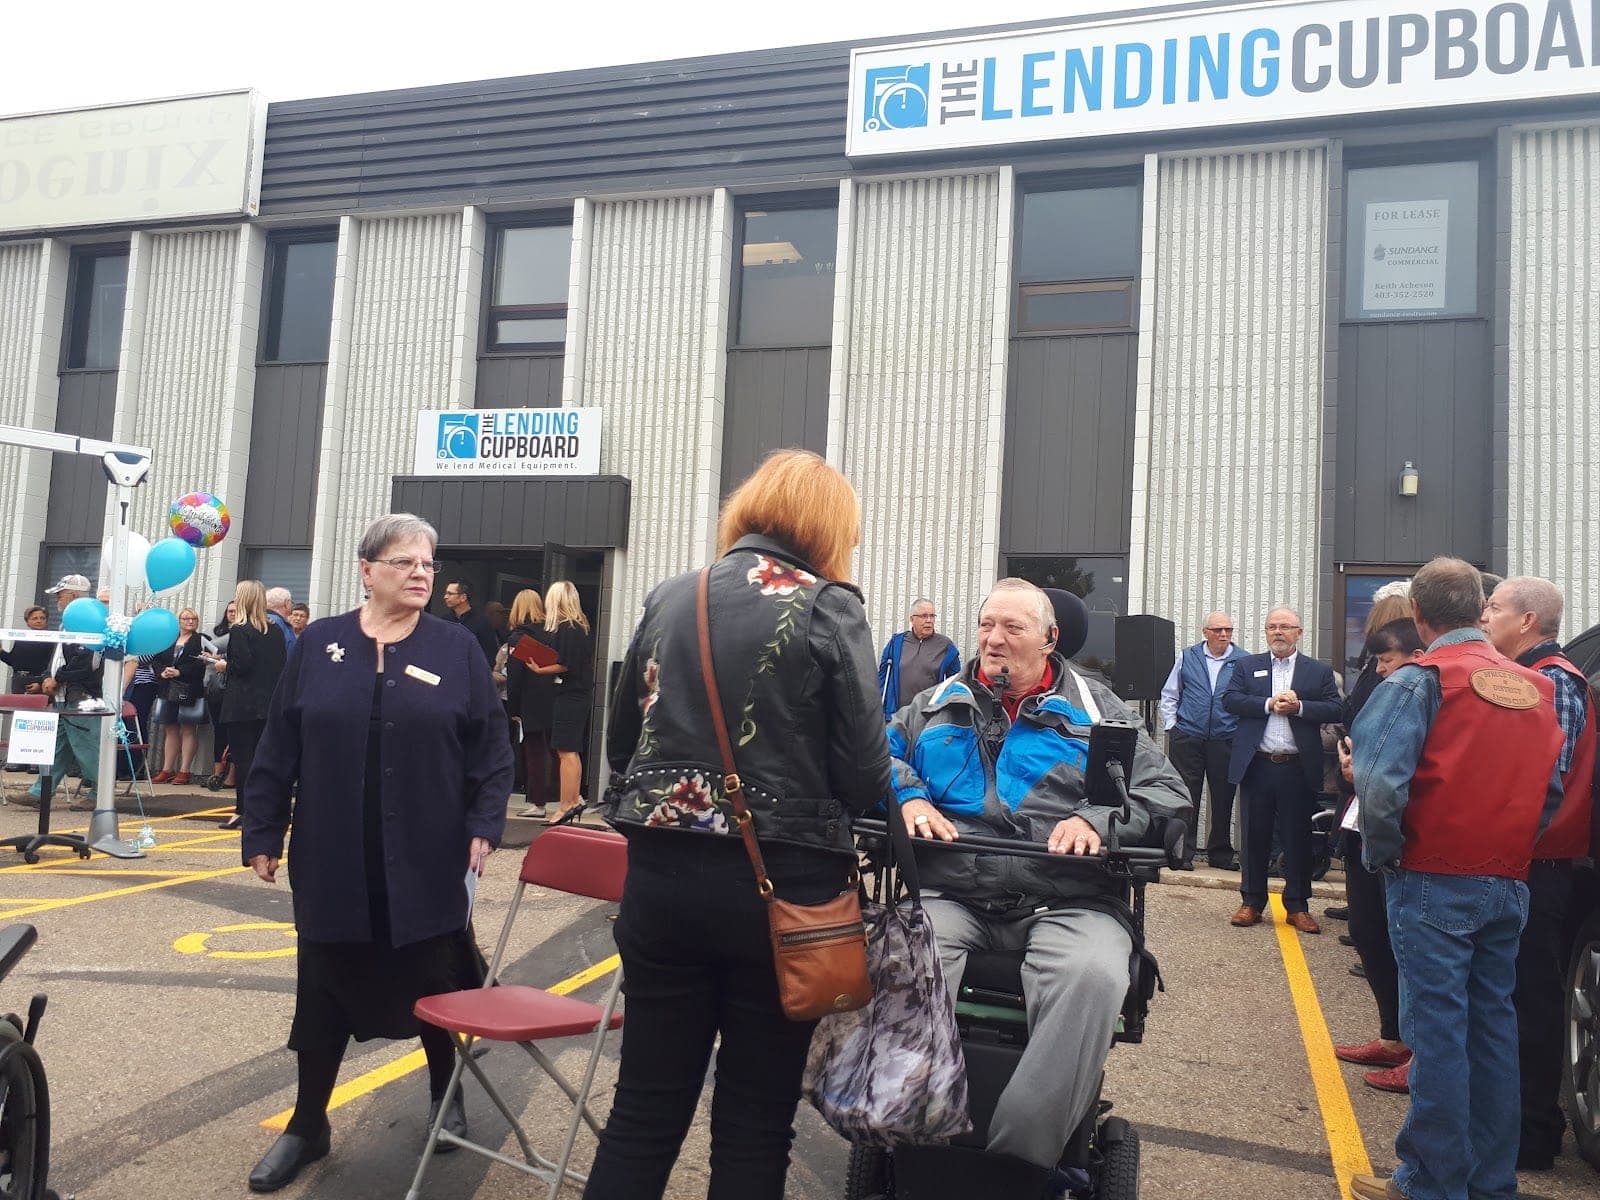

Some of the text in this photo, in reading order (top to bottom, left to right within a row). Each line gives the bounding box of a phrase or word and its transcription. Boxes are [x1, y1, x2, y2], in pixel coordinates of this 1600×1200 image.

[940, 0, 1600, 125] THE LENDING CUPBOA
[1374, 209, 1440, 221] FOR LEASE
[1388, 246, 1440, 255] SUNDANCE
[1387, 258, 1439, 266] COMMERCIAL
[1374, 281, 1398, 290] Keith
[482, 411, 579, 436] THE LENDING
[480, 435, 580, 459] CUPBOARD
[436, 461, 578, 471] We lend Medical Equipment.
